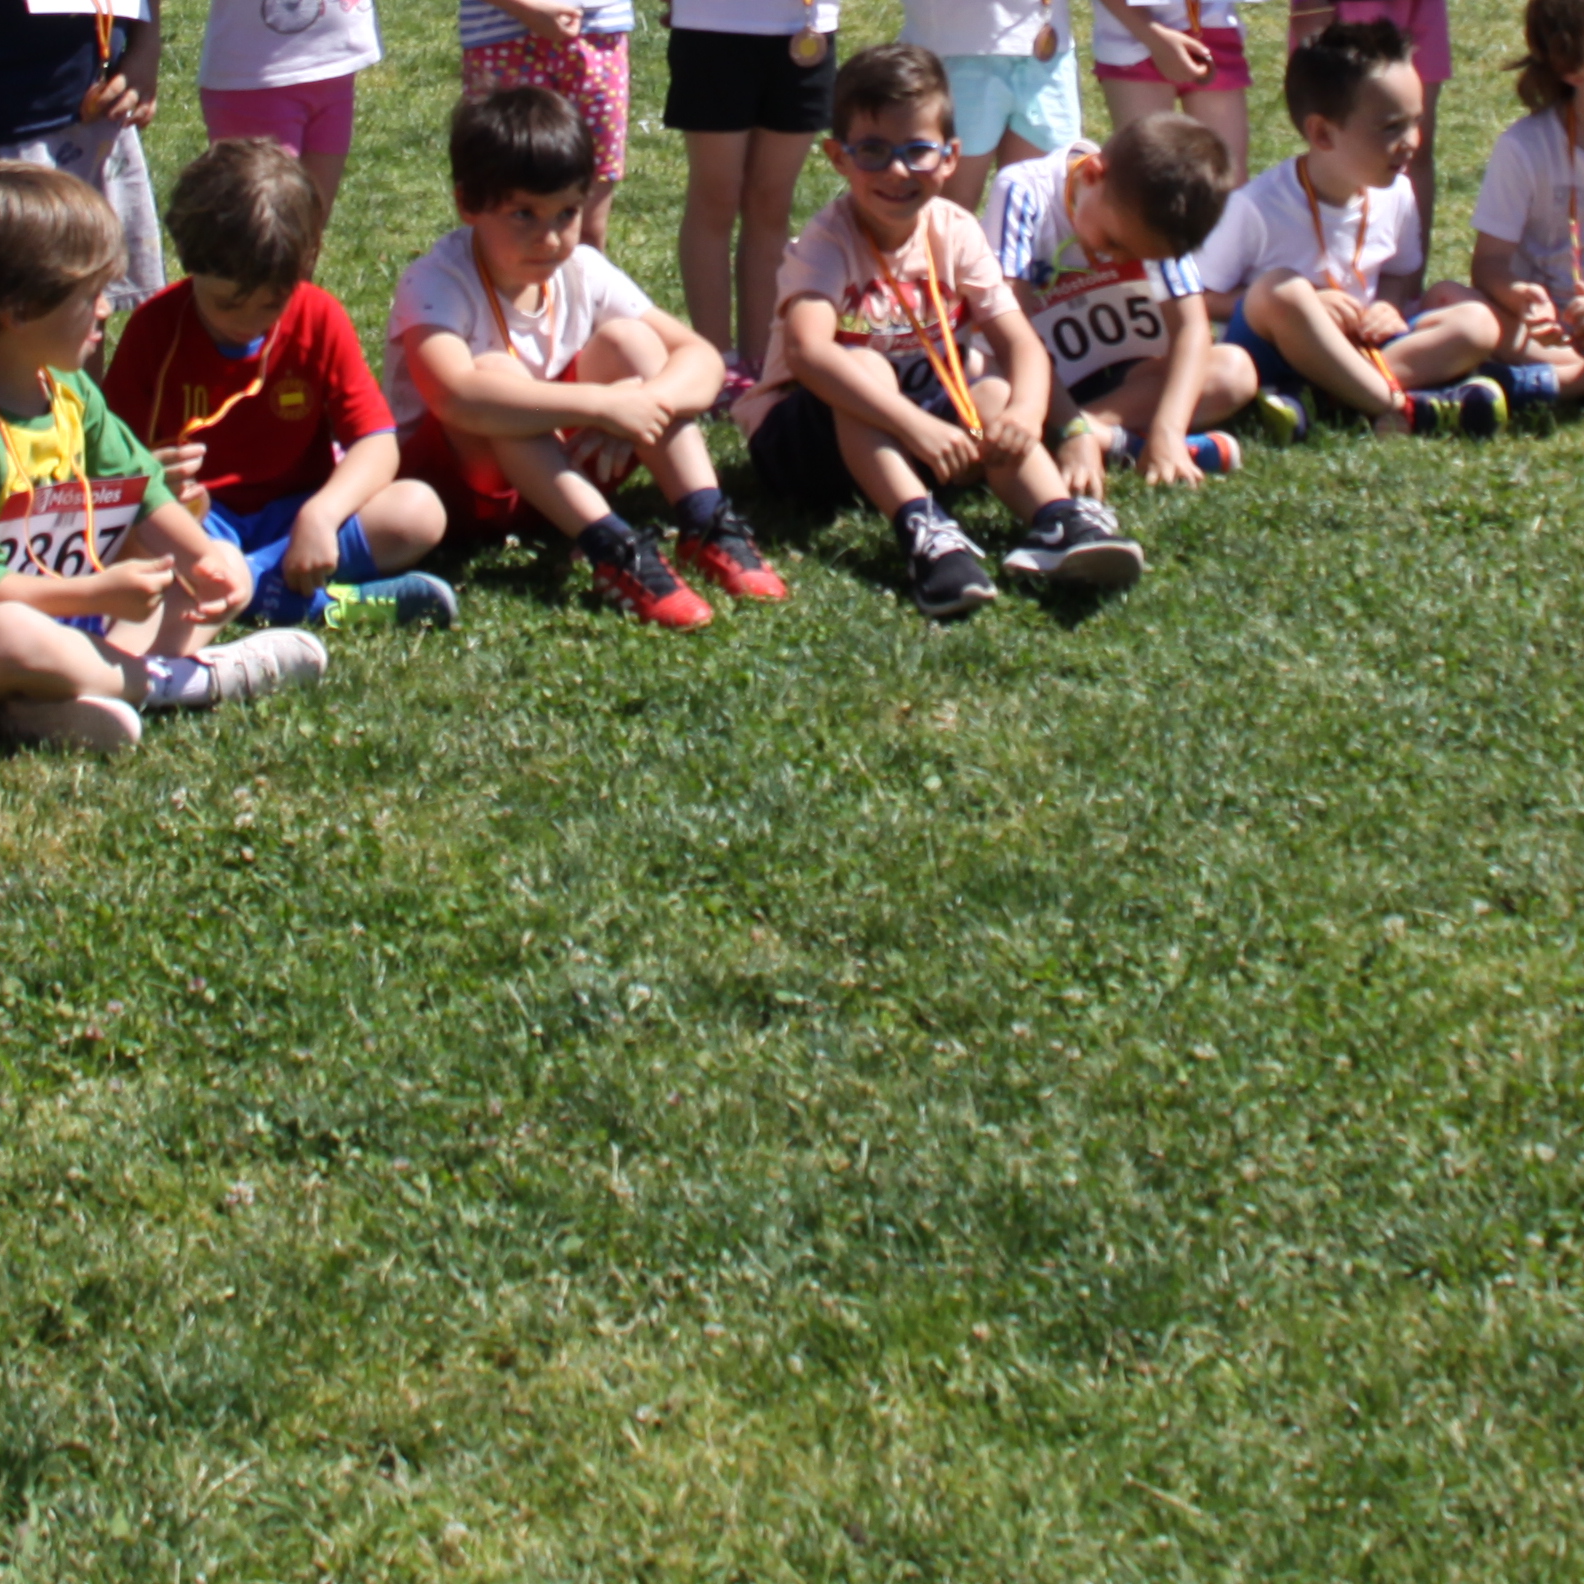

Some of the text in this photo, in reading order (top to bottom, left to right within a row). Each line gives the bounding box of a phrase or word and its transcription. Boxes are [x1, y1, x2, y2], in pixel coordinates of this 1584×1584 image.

[1051, 295, 1162, 364] 005
[182, 383, 208, 424] 10
[49, 486, 123, 509] Mósoles
